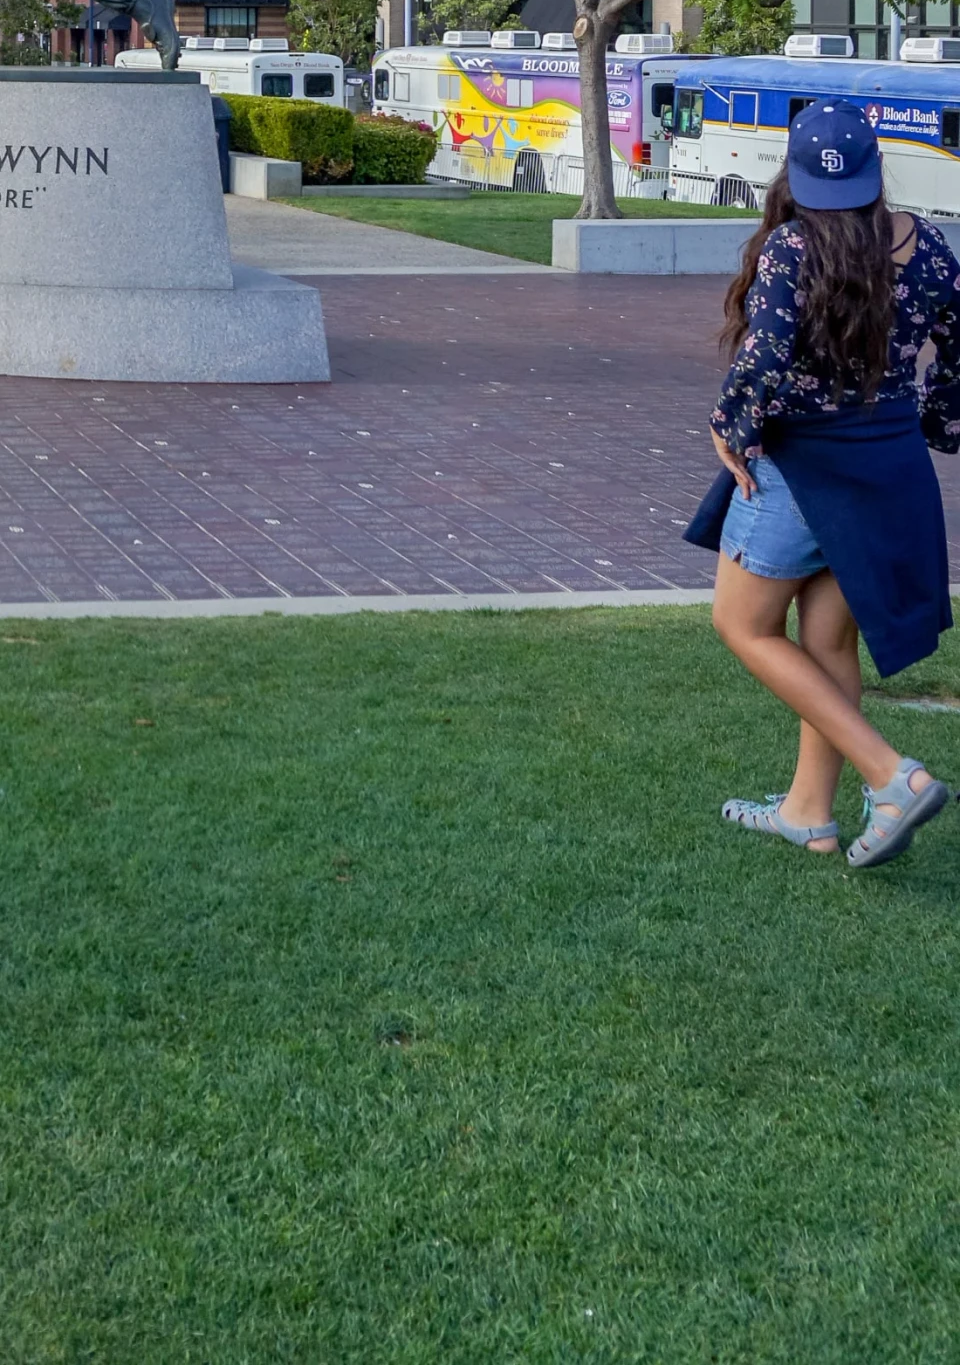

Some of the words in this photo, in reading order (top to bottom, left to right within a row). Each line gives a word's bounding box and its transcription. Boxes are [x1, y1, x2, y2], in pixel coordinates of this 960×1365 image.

[522, 58, 624, 76] BLOODMLE
[882, 106, 910, 122] Blood
[912, 108, 939, 124] Bank
